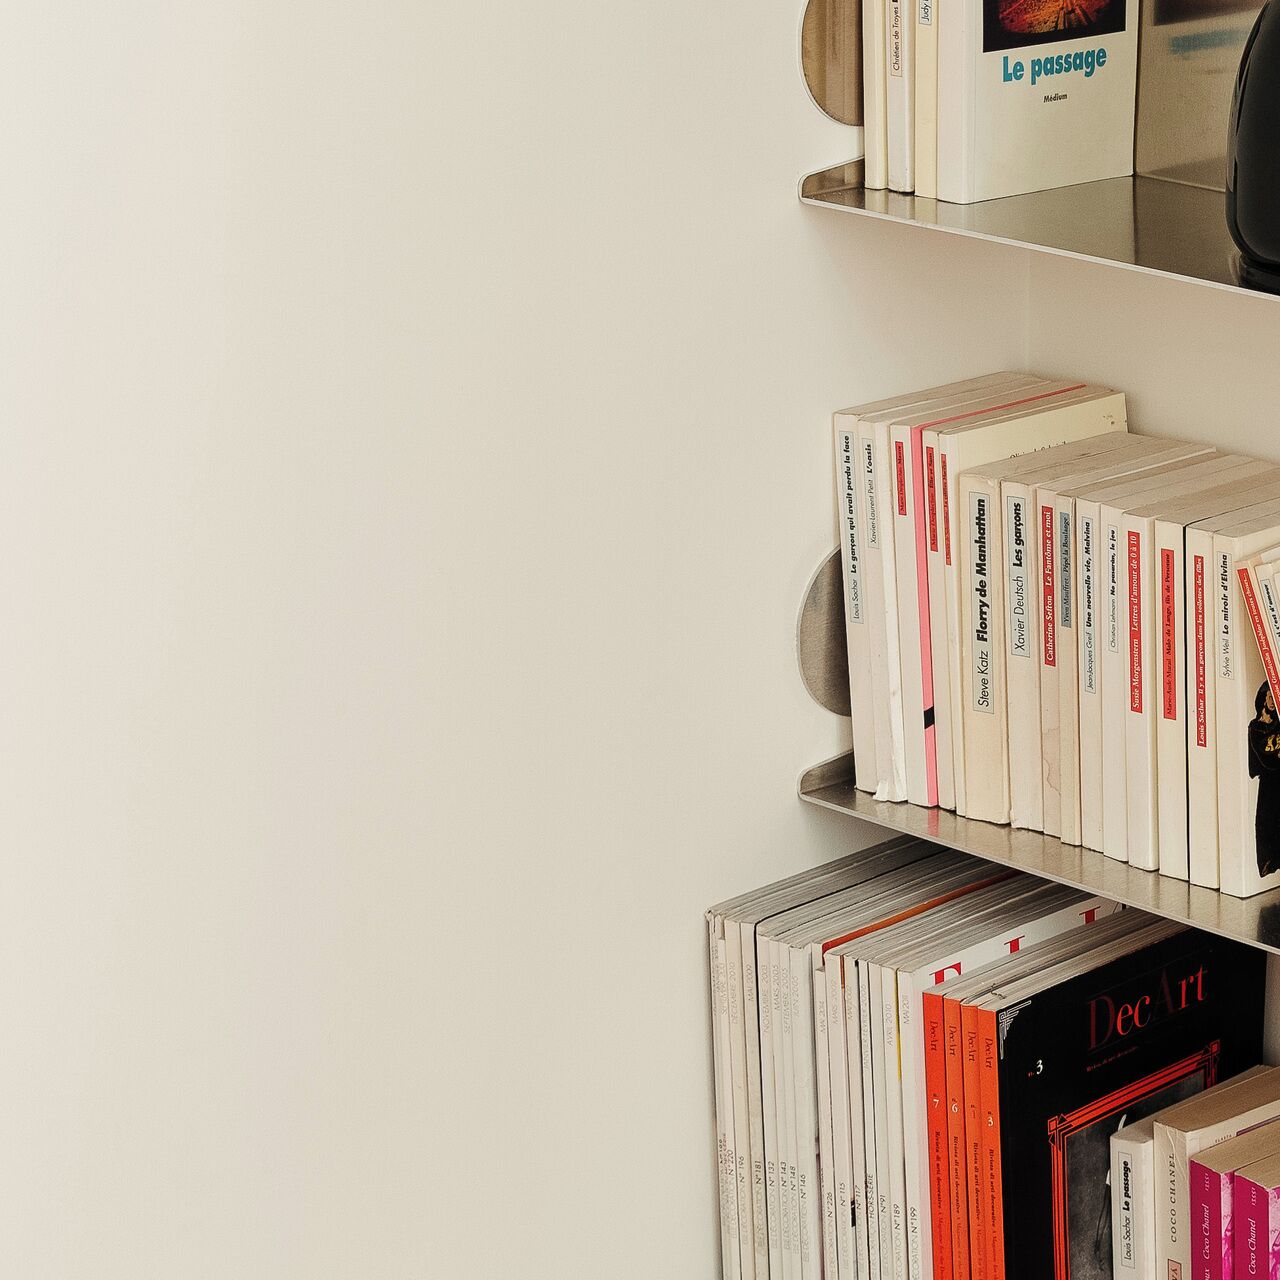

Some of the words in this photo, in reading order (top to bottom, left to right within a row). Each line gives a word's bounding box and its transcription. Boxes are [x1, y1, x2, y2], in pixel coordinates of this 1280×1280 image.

[921, 2, 932, 21] Judy
[1002, 55, 1024, 83] Le
[1031, 46, 1107, 86] passage
[1043, 92, 1068, 103] Médium
[974, 498, 986, 578] Manhattan
[1012, 502, 1025, 547] garçons
[1012, 548, 1023, 568] Les
[975, 578, 986, 598] de
[1013, 575, 1025, 616] Deutsch
[975, 599, 990, 643] Florry
[1014, 617, 1025, 652] Xavier
[977, 649, 989, 675] Katz
[977, 676, 989, 707] Steve
[1086, 964, 1208, 1051] DecArt
[1122, 1160, 1132, 1199] passage
[1168, 1153, 1177, 1204] CHANEL
[1122, 1200, 1130, 1212] Le
[1201, 1203, 1210, 1236] Chanel
[1123, 1215, 1131, 1241] Sachar
[1168, 1207, 1177, 1243] COCO
[1247, 1218, 1256, 1252] Chanel
[1123, 1242, 1131, 1261] Louis
[1202, 1237, 1211, 1260] Coco
[1247, 1252, 1257, 1275] Coco
